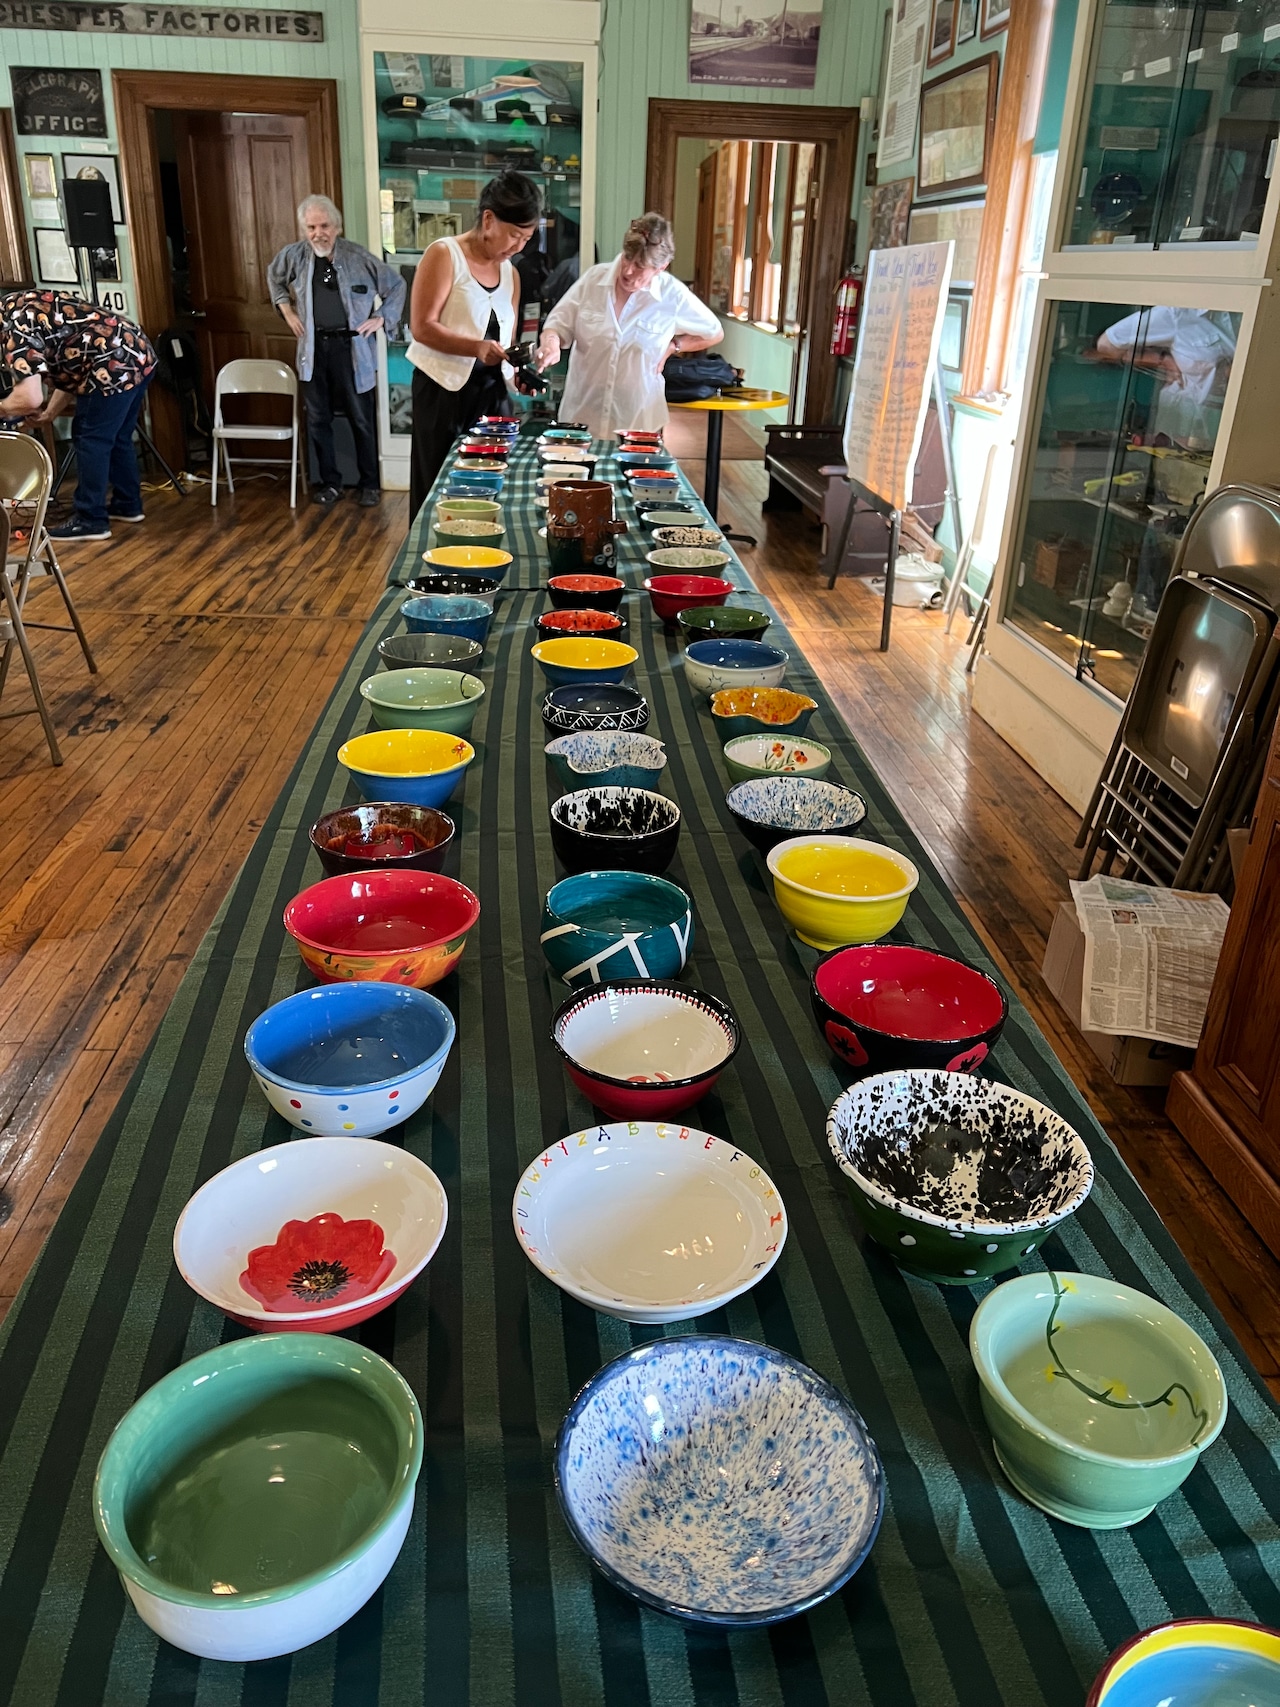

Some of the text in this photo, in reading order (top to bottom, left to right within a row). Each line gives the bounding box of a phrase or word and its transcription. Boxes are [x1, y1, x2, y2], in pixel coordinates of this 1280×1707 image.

[146, 10, 319, 36] FACTORIES.
[598, 1126, 611, 1142] A
[627, 1122, 640, 1136] B
[656, 1124, 666, 1138] C
[679, 1128, 690, 1140] D
[576, 1133, 588, 1146] Z
[704, 1136, 717, 1150] E
[556, 1141, 569, 1156] Y
[540, 1152, 553, 1168] X
[729, 1151, 744, 1162] F
